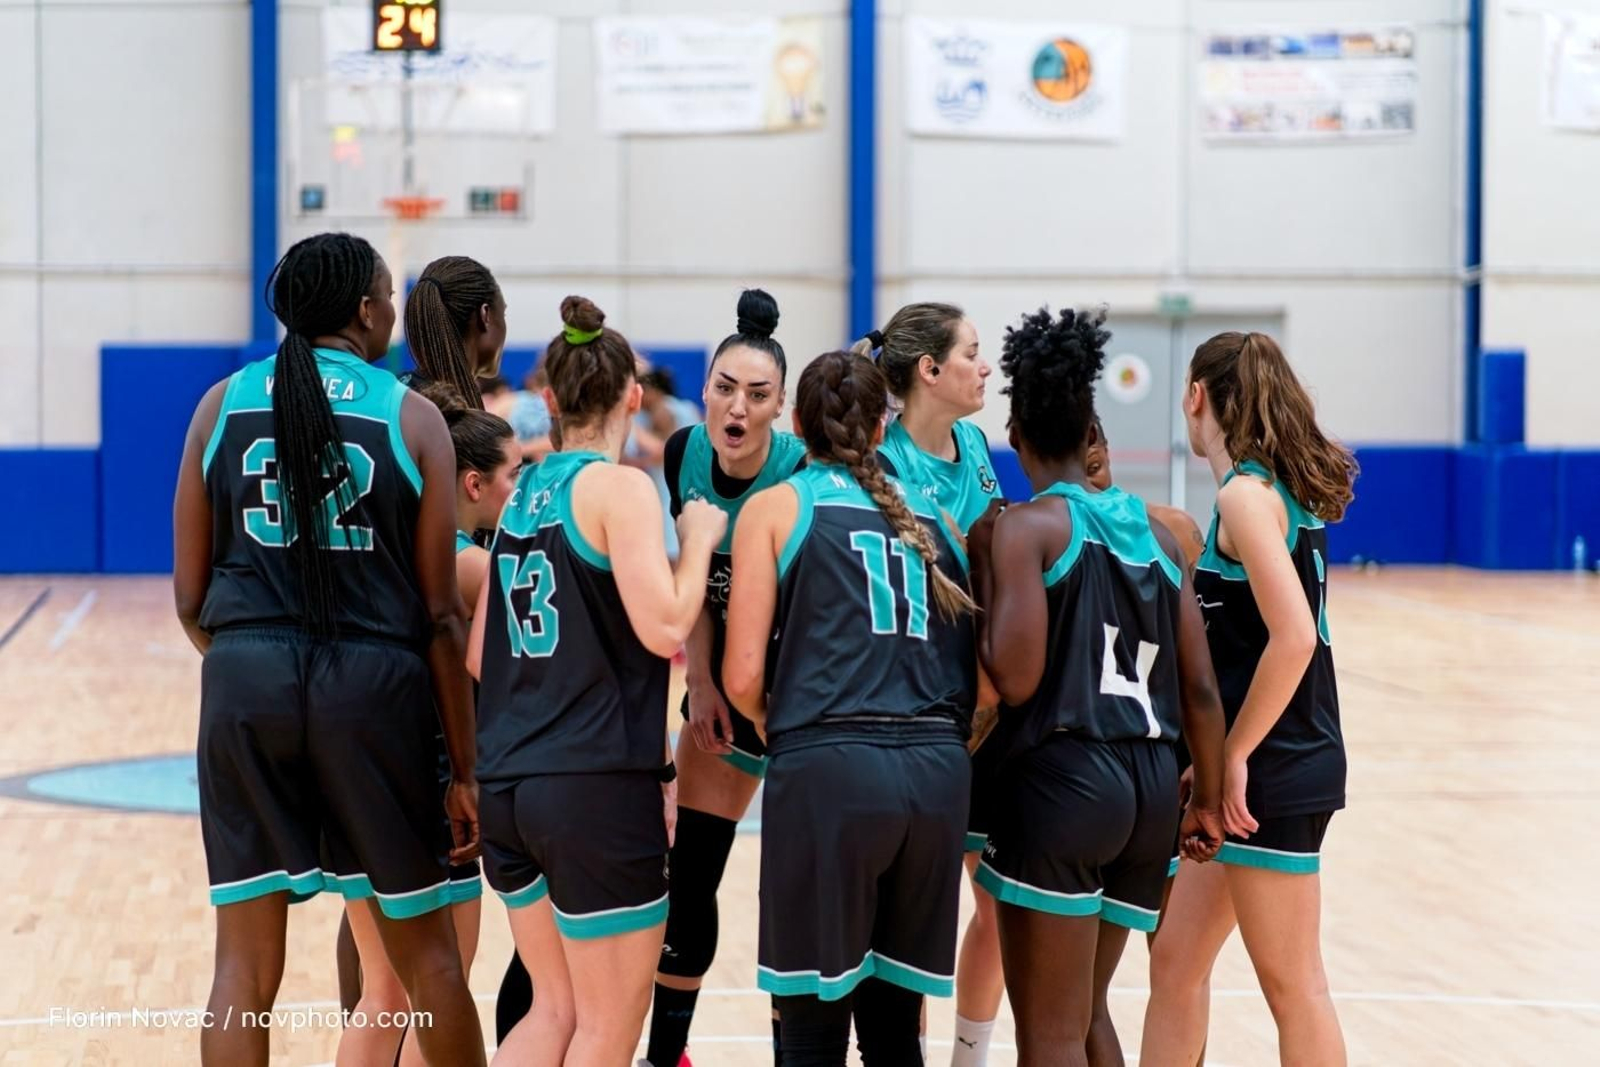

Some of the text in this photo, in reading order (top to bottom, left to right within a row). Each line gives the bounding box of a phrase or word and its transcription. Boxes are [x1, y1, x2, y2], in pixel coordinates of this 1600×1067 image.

[377, 4, 437, 48] 24
[242, 438, 375, 551] 32
[498, 550, 559, 658] 13
[849, 530, 929, 641] 11
[1099, 622, 1161, 739] 4
